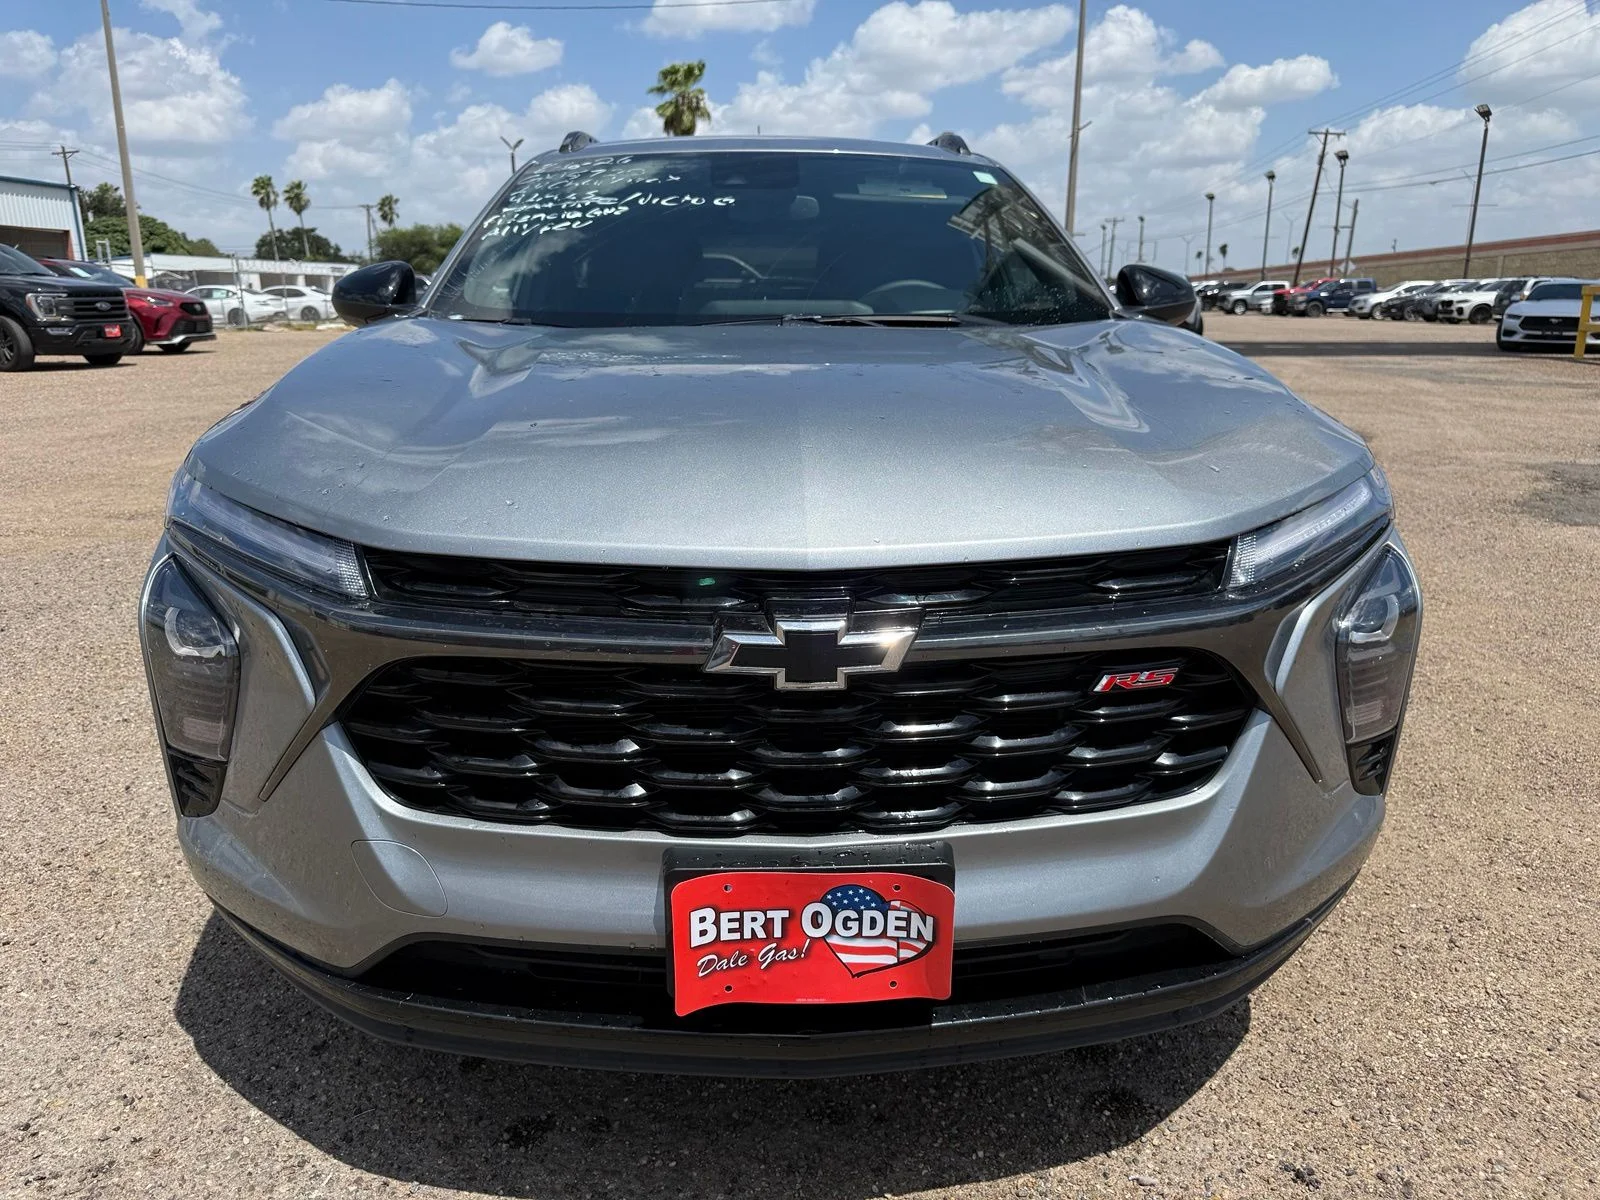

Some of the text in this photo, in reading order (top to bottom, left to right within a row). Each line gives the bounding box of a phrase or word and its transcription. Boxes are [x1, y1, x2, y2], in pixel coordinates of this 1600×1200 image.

[1093, 667, 1179, 692] RS
[689, 901, 936, 949] BERT OGDEN
[696, 938, 811, 978] Dale Gas!
